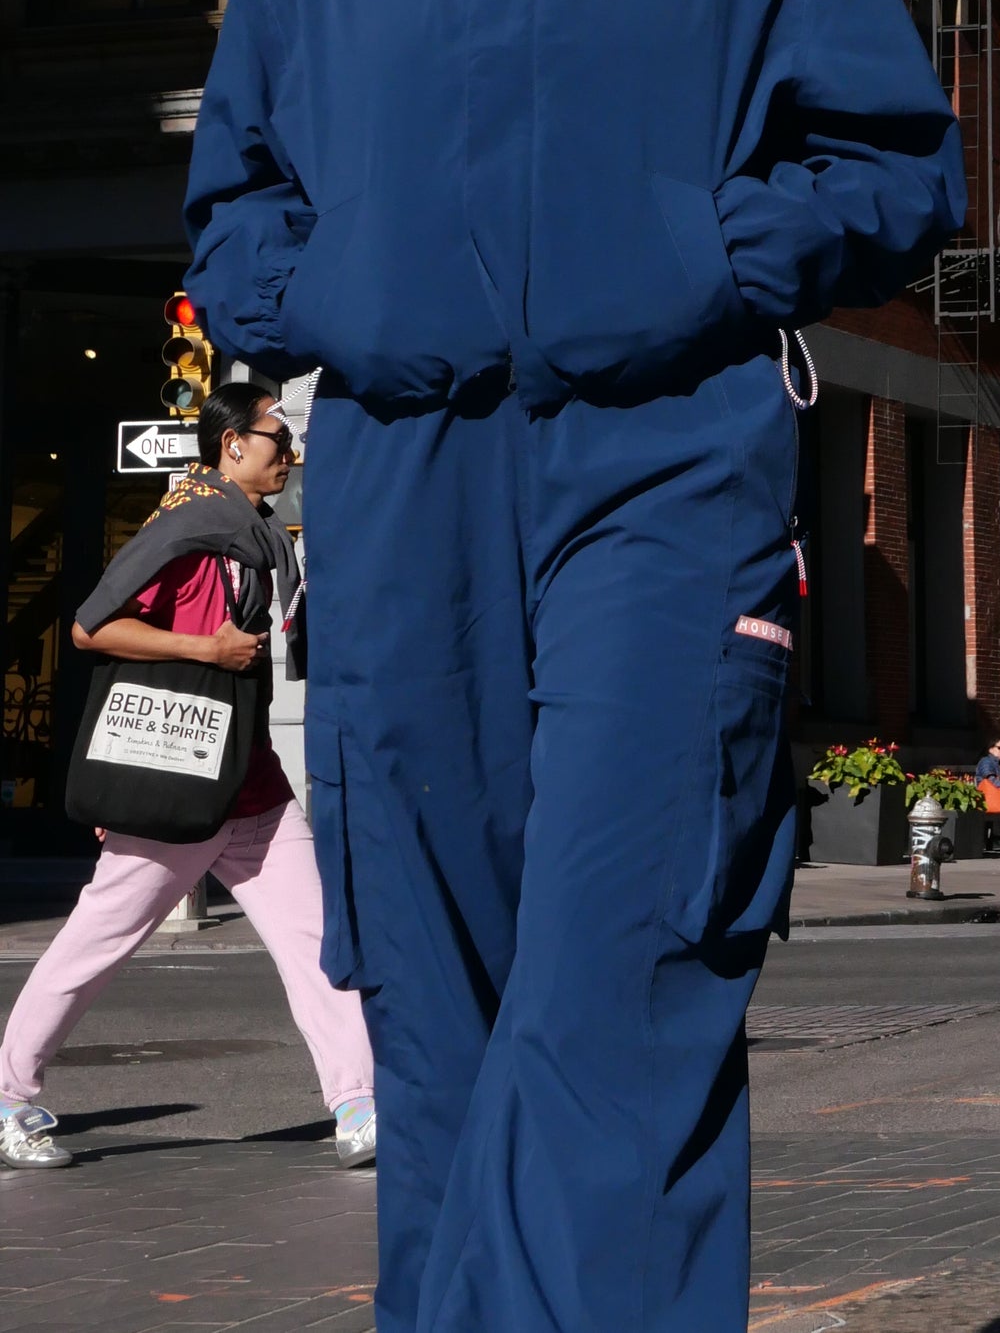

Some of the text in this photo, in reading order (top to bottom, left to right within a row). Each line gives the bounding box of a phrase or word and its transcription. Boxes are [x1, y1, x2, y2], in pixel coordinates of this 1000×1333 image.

[141, 438, 177, 454] ONE
[739, 619, 783, 641] HOUSE
[108, 692, 223, 731] BED-VYNE
[106, 714, 217, 744] WINE & SPIRITS
